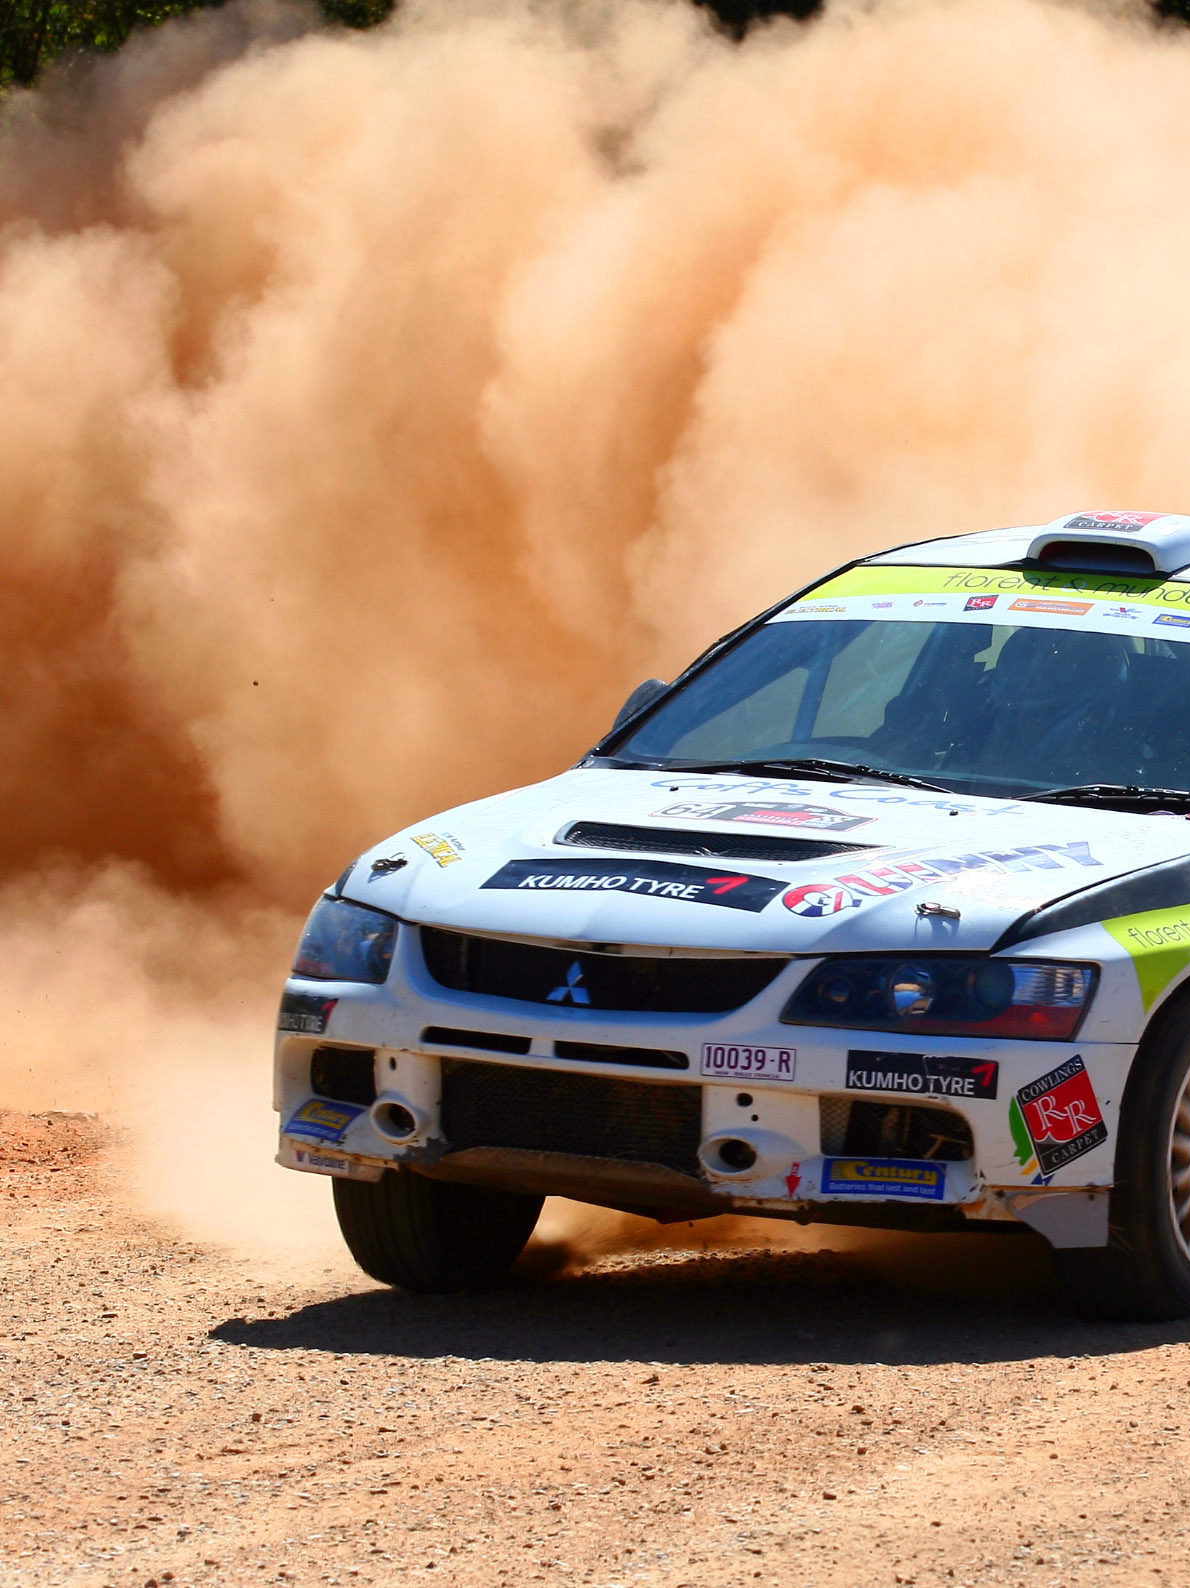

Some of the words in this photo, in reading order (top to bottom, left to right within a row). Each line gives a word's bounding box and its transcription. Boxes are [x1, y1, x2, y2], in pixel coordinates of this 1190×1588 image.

[1078, 521, 1134, 530] CARPET
[943, 571, 1062, 592] florent
[650, 777, 814, 798] Coffs
[829, 788, 1027, 817] Coast
[661, 803, 721, 818] 64
[517, 873, 627, 892] KUMHO
[633, 876, 705, 900] TYRE
[848, 1069, 923, 1091] KUMHO
[925, 1074, 976, 1096] TYRE
[1021, 1058, 1084, 1102] COWLINGS
[1032, 1095, 1098, 1136] RR
[1051, 1128, 1100, 1163] CARPET
[831, 1159, 939, 1186] Century
[829, 1182, 867, 1192] Batteries
[868, 1183, 885, 1192] that
[902, 1185, 920, 1194] and
[919, 1186, 937, 1196] last
